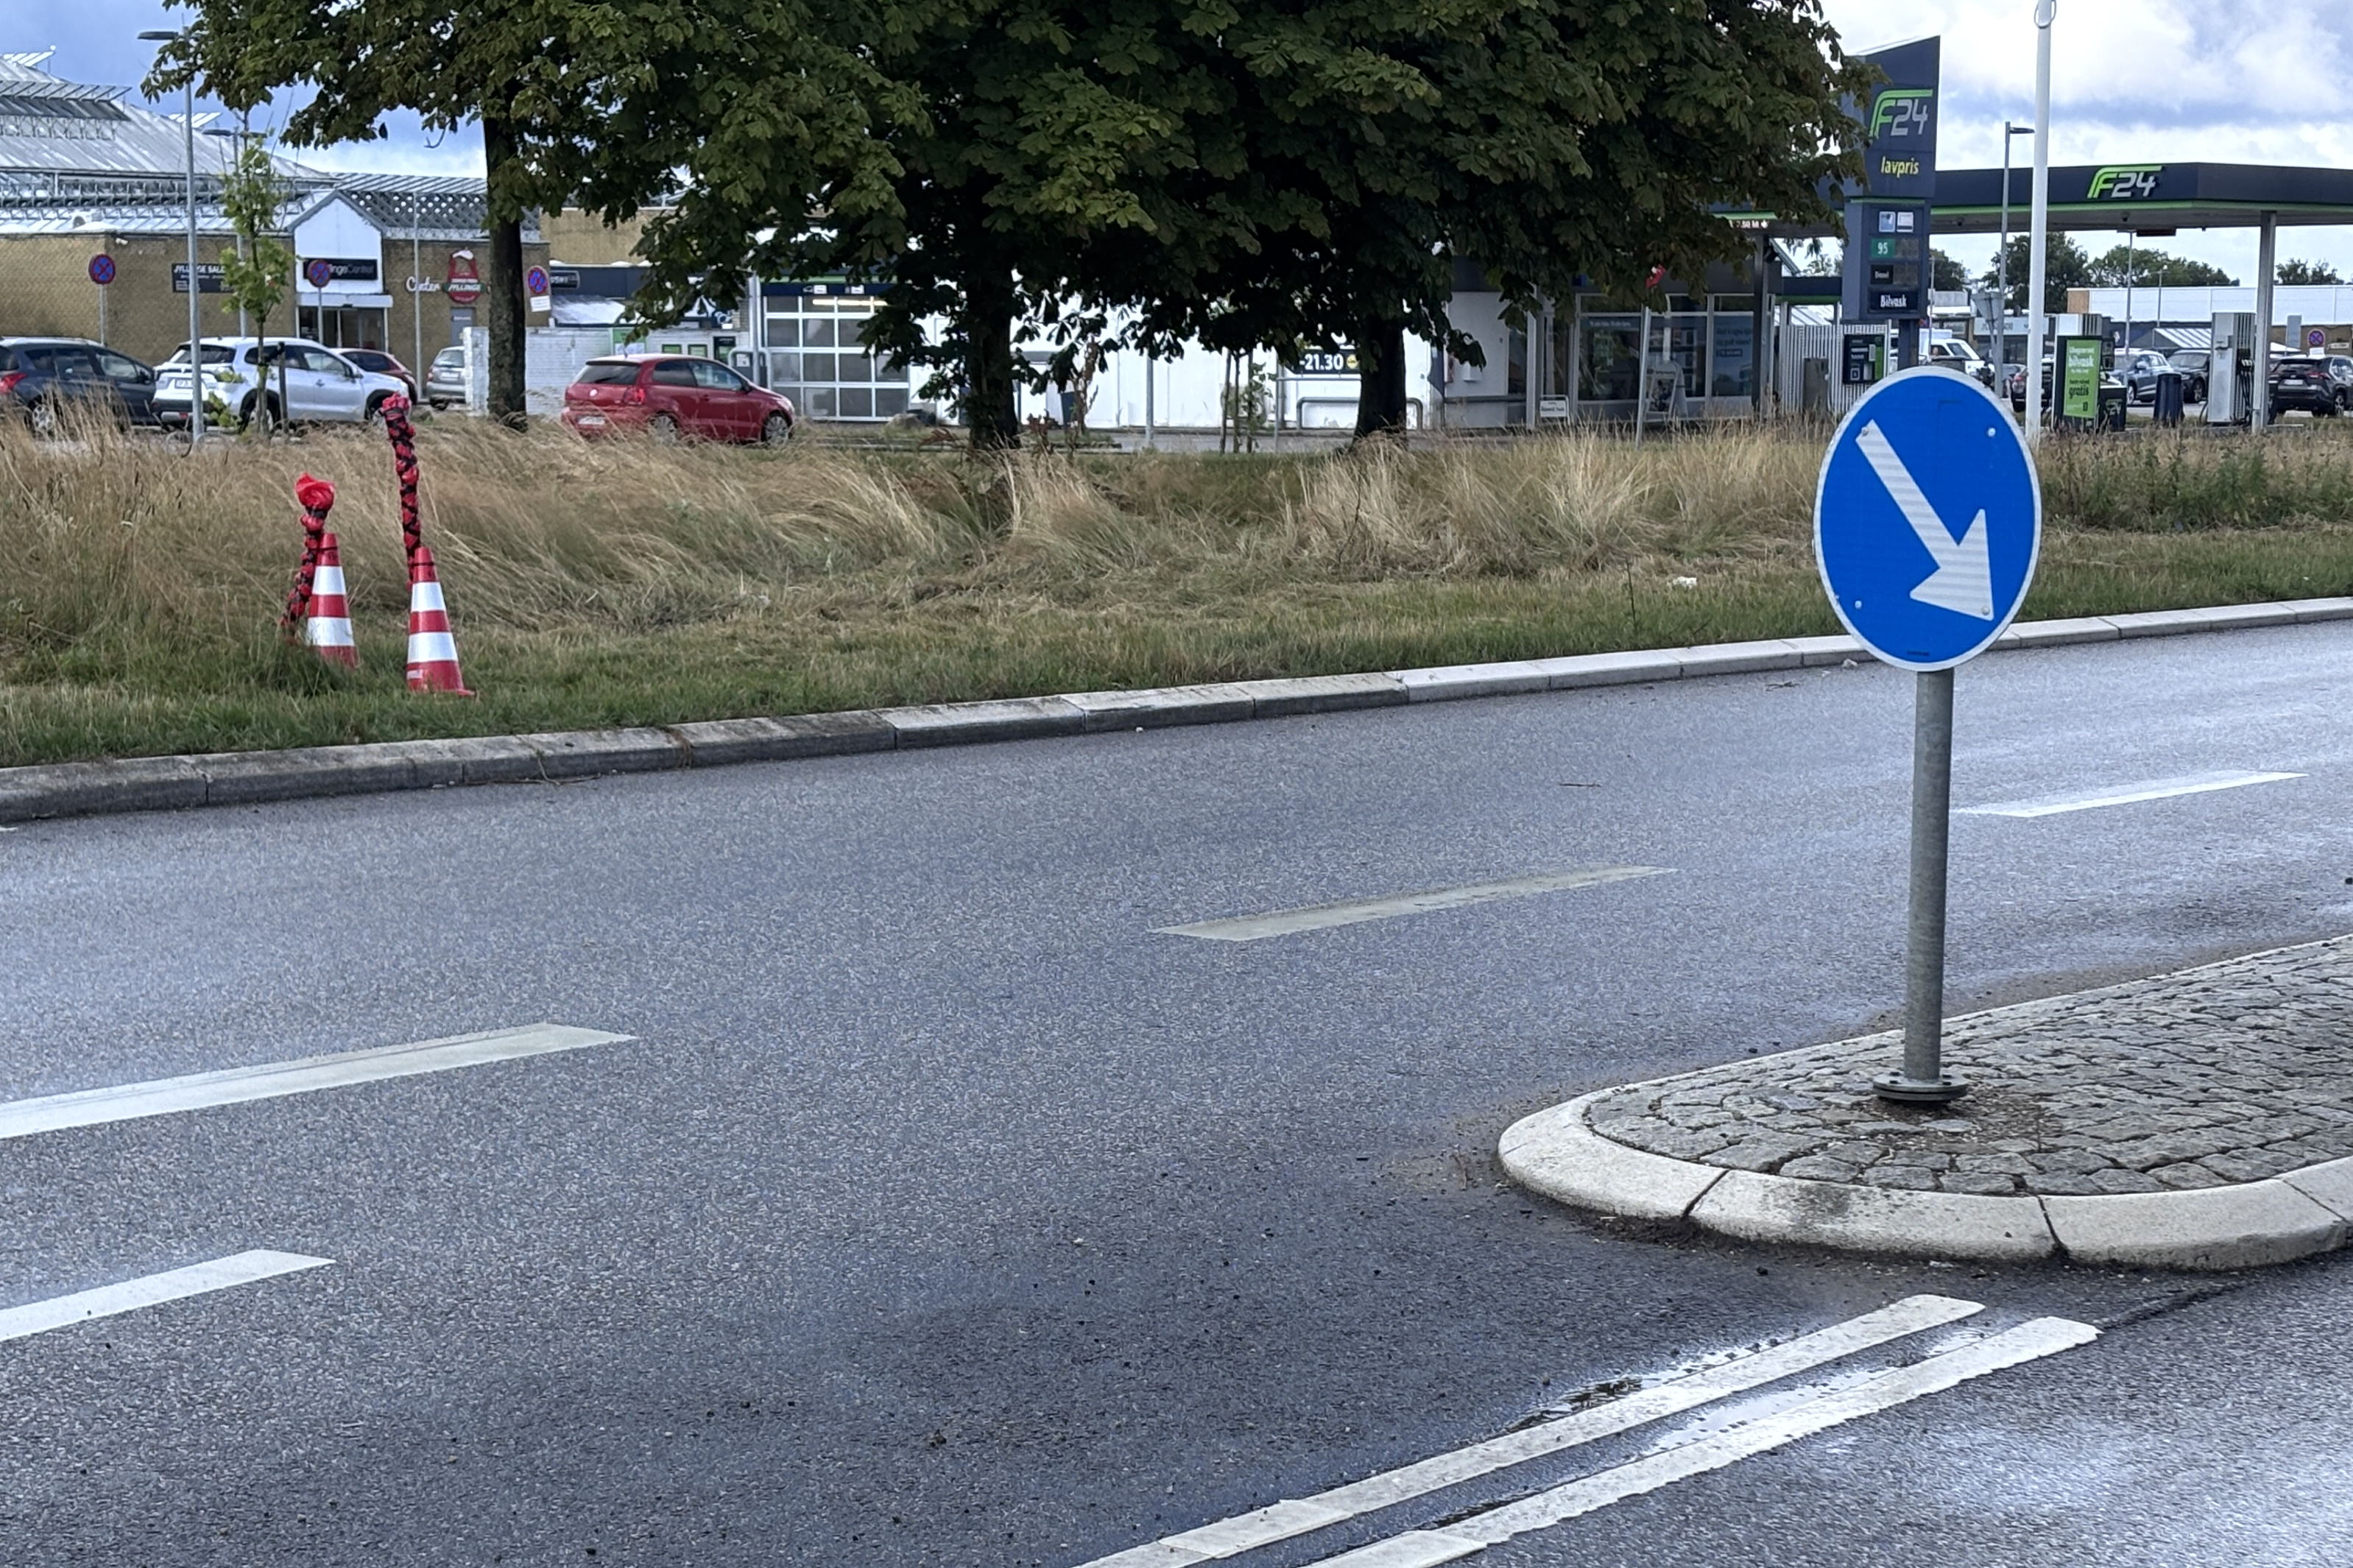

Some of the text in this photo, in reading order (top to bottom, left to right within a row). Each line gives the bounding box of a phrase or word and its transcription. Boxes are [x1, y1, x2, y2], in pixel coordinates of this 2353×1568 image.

[1869, 89, 1933, 139] F24
[1881, 155, 1919, 178] lavpris
[2087, 165, 2163, 199] F24
[1877, 241, 1888, 255] 95
[174, 265, 207, 274] JYLLGE
[1880, 294, 1908, 308] Bilvask
[1299, 353, 1344, 370] -21.30
[2068, 386, 2089, 400] gratis
